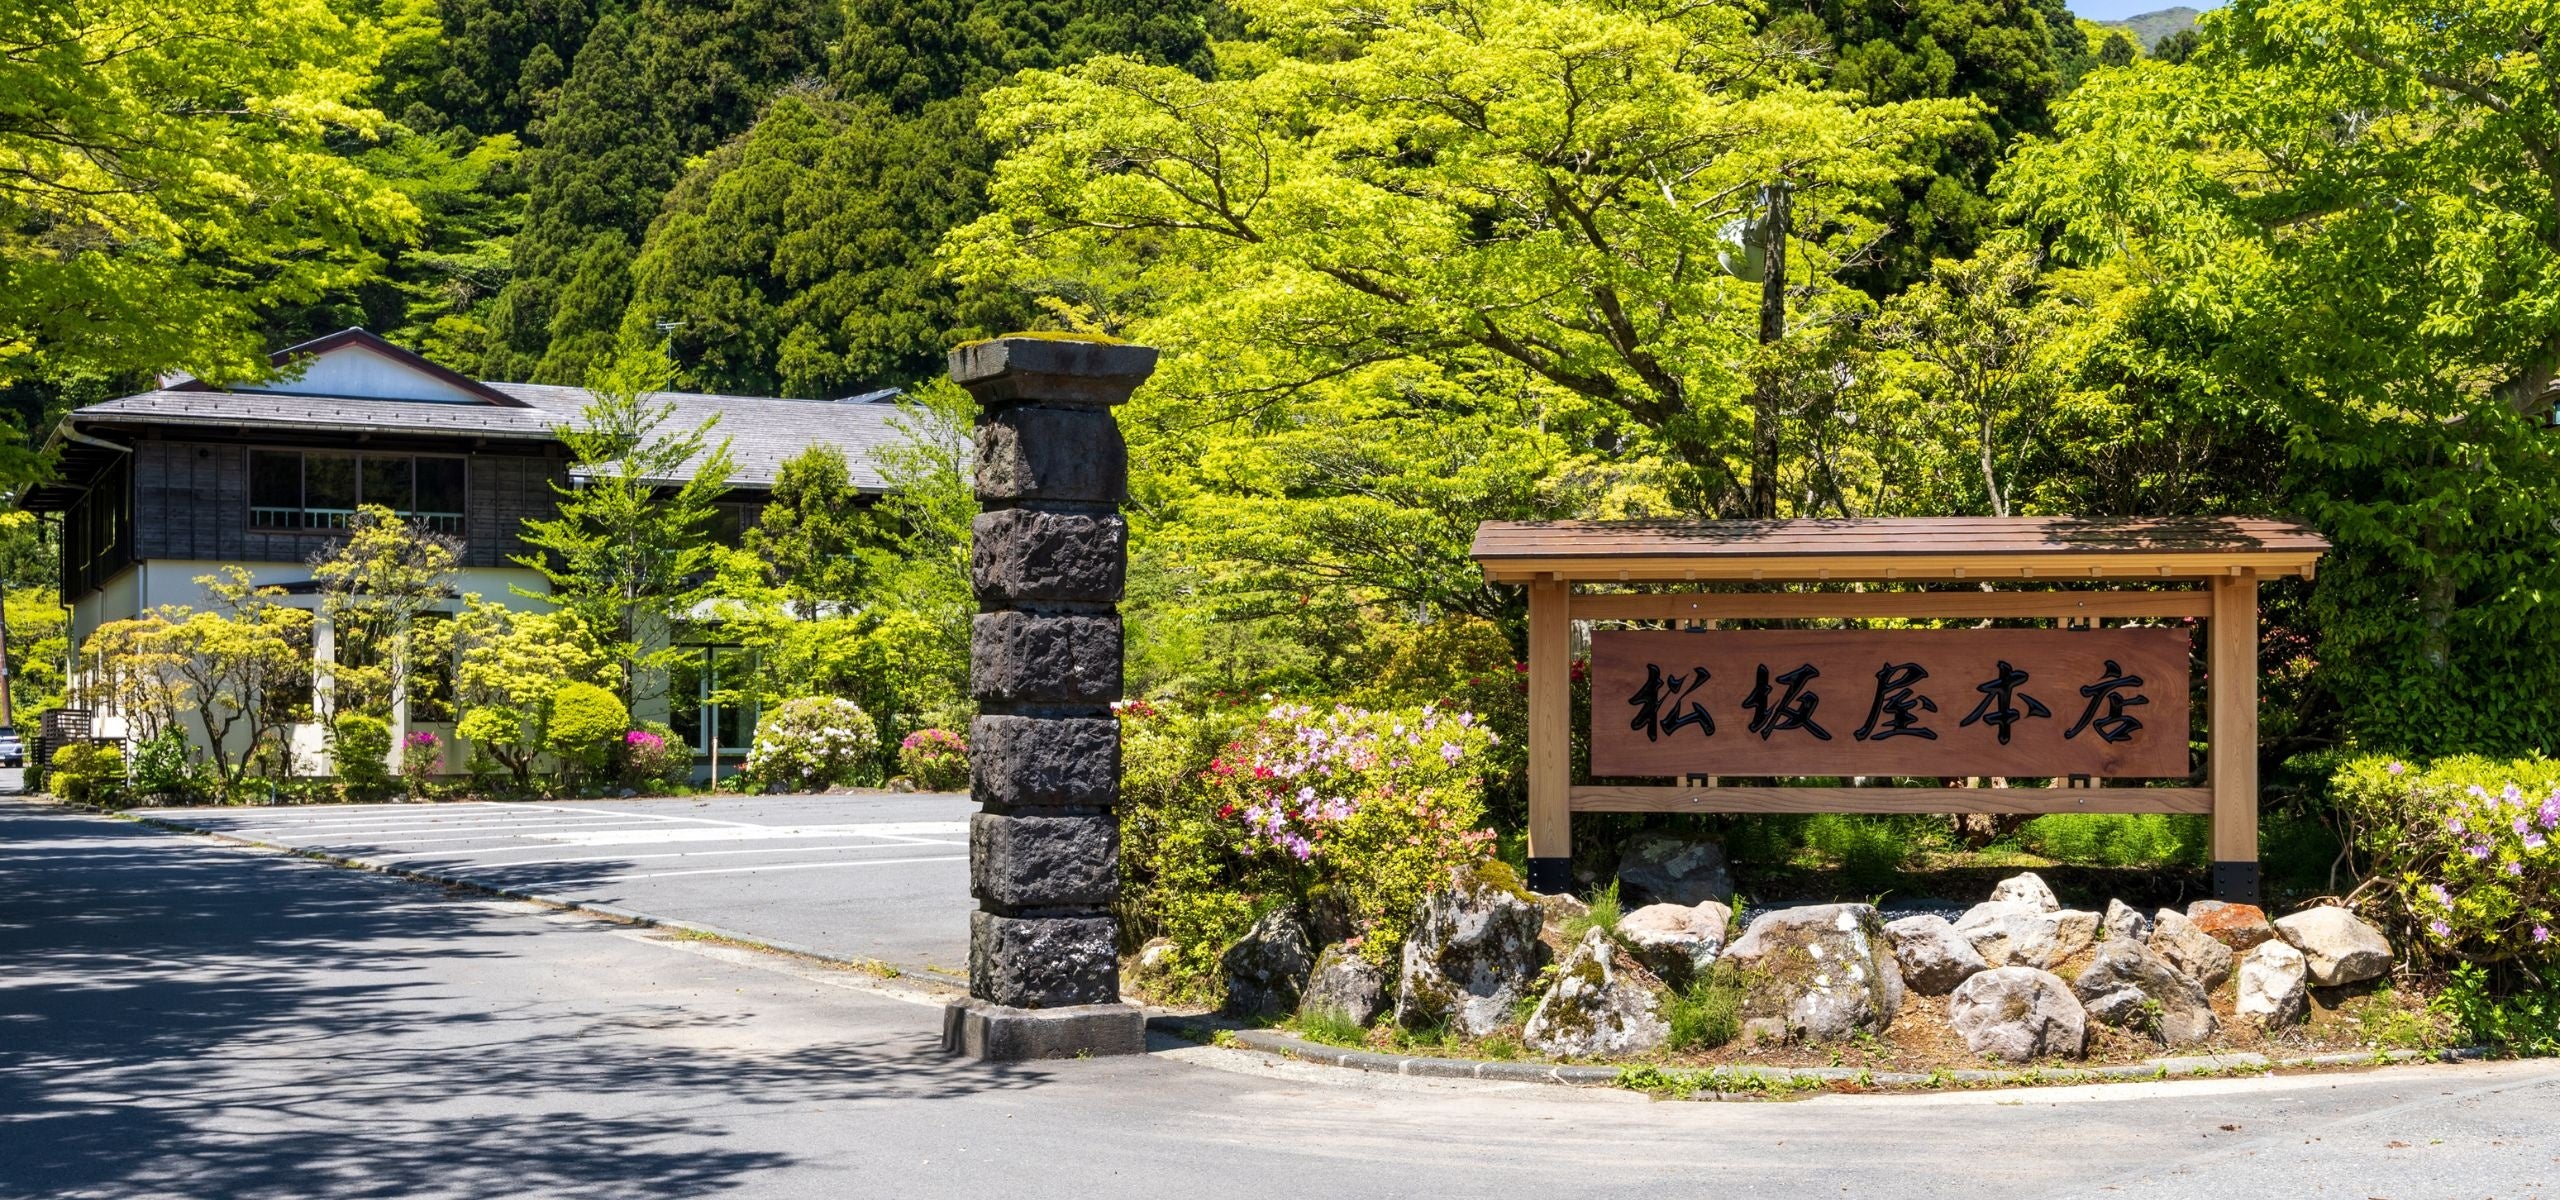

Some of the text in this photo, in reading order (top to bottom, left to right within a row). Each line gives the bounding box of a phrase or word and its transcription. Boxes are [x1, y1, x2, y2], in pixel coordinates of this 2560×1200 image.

[1628, 660, 2150, 745] 松坂屋本店
